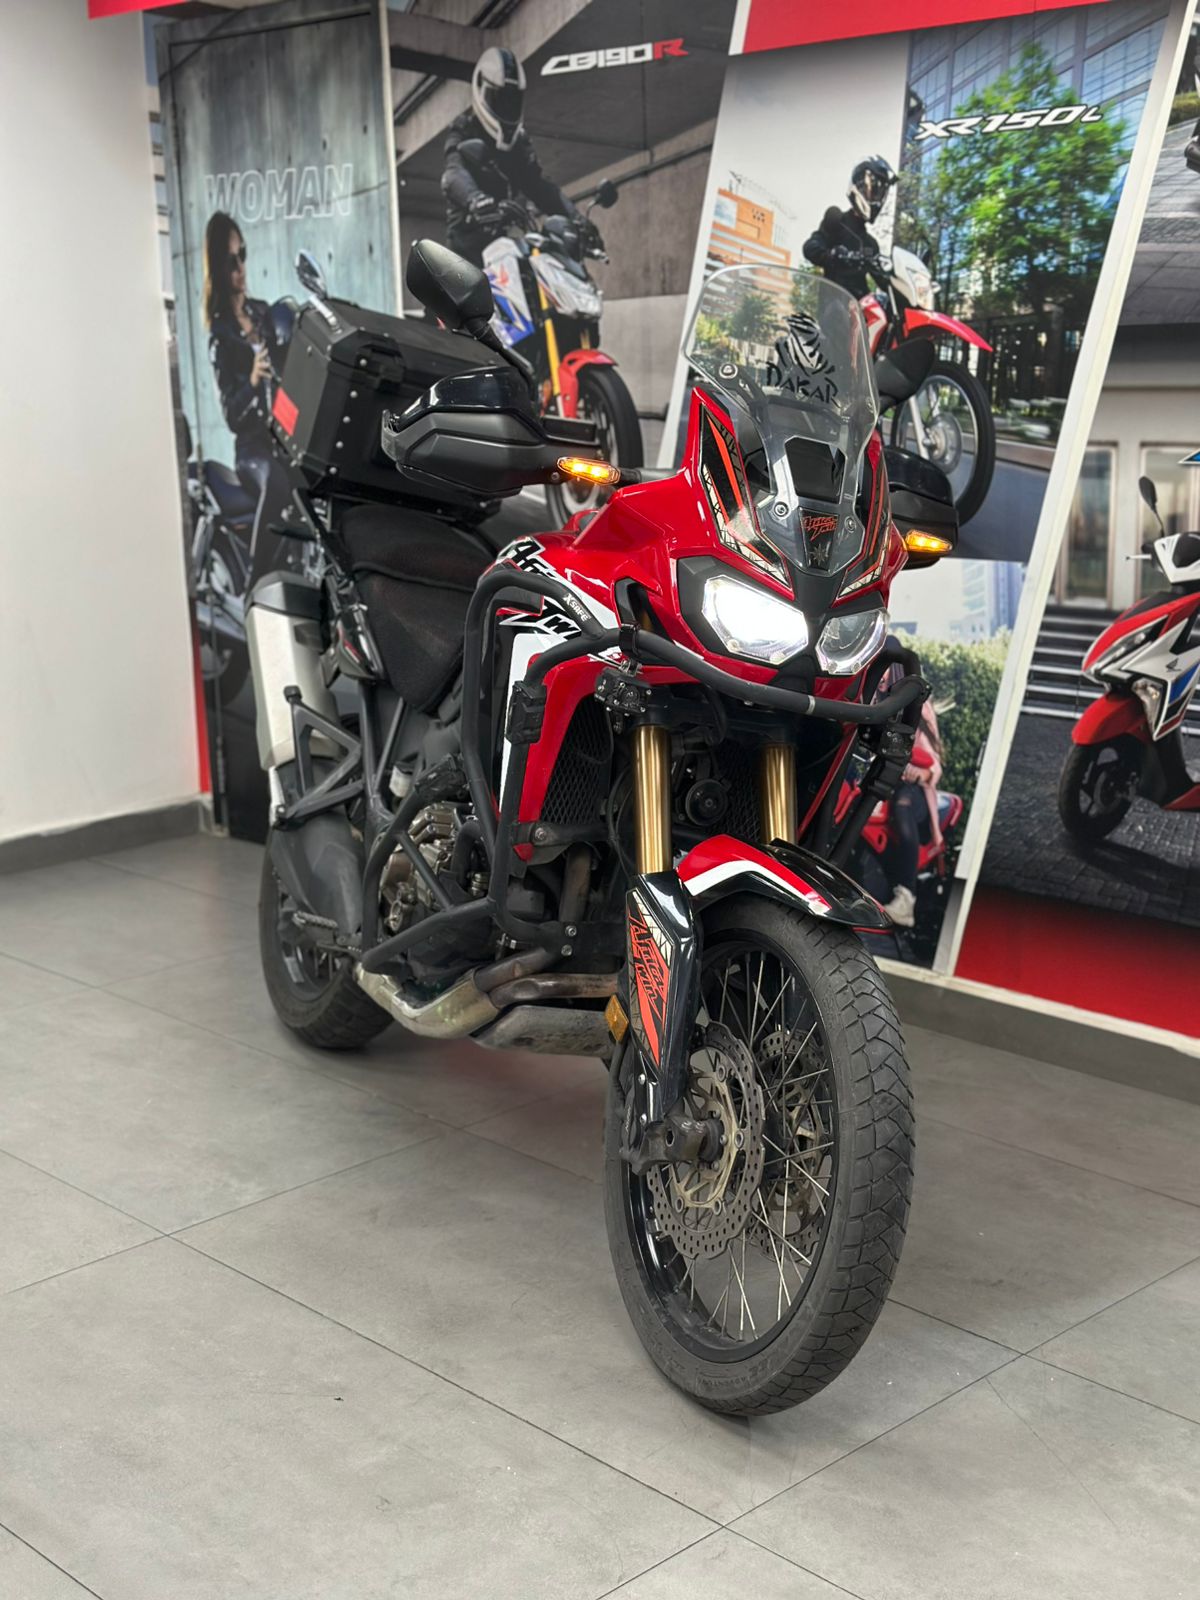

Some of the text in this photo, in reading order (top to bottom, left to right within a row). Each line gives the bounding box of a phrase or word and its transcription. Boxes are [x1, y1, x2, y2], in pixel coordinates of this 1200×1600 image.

[540, 38, 689, 76] CB190R
[913, 104, 1102, 140] XR150L
[205, 163, 353, 223] WOMAN
[766, 361, 841, 408] DAKAR
